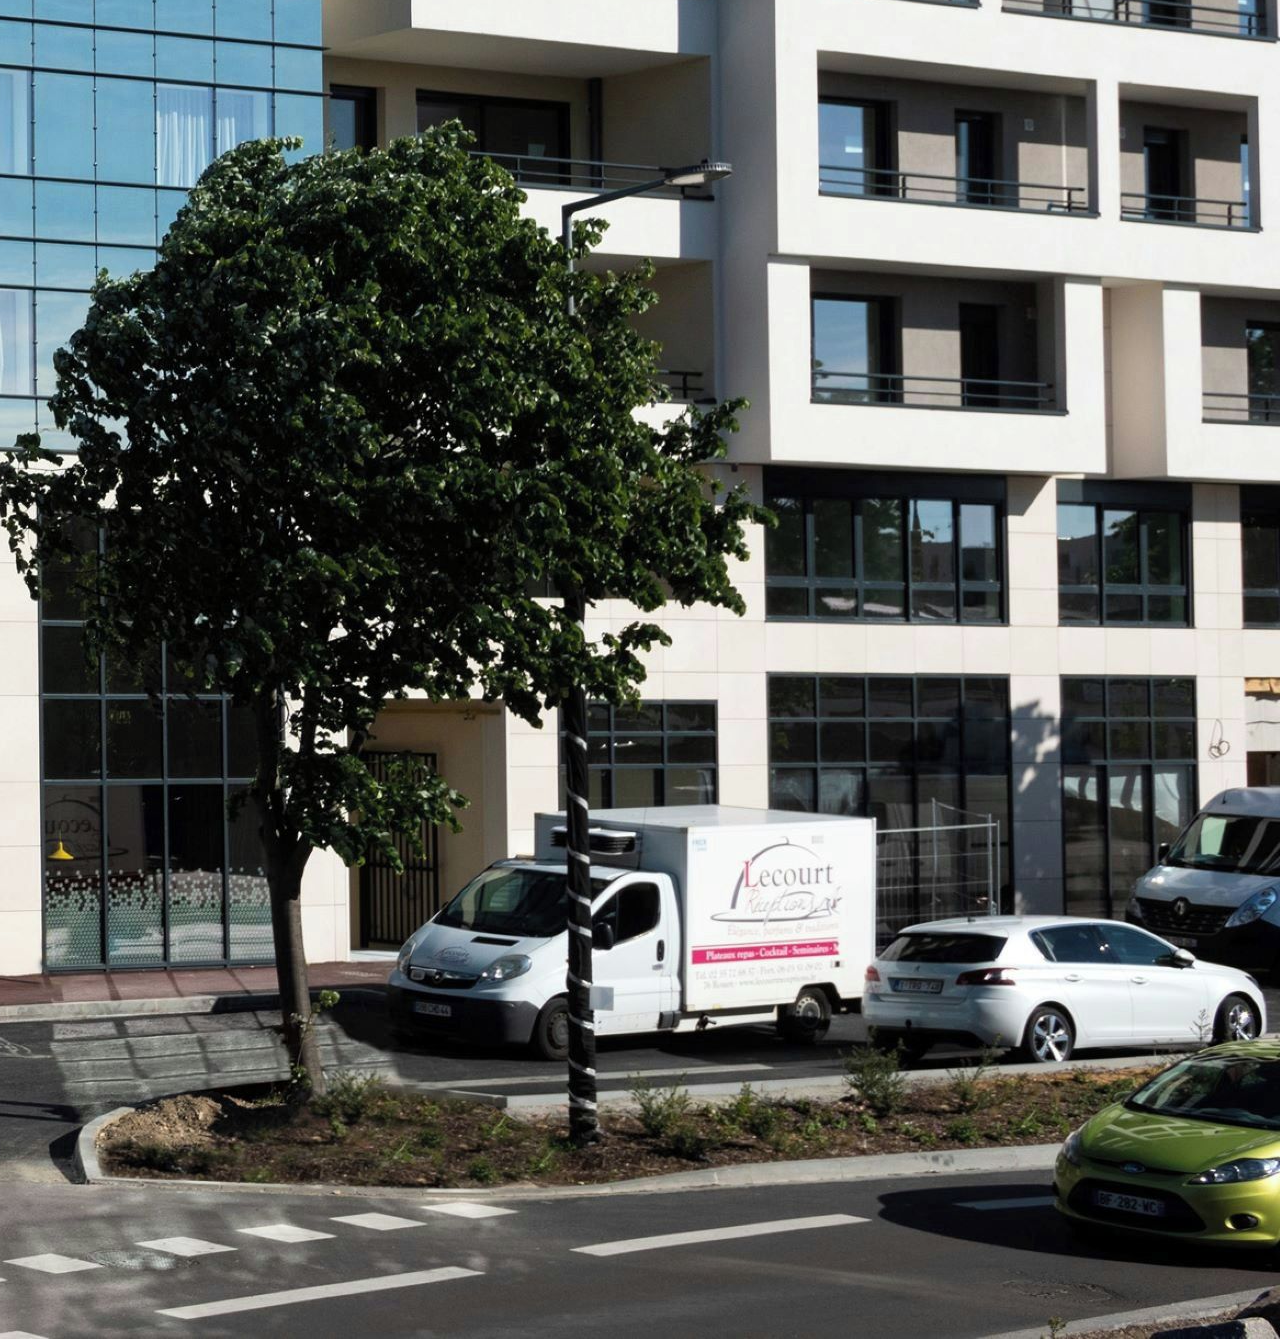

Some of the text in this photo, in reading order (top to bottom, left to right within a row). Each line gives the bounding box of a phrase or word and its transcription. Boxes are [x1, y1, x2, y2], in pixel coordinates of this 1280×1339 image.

[744, 860, 833, 887] Lecourt
[706, 950, 736, 961] Plateaux
[759, 946, 788, 958] Cocktail
